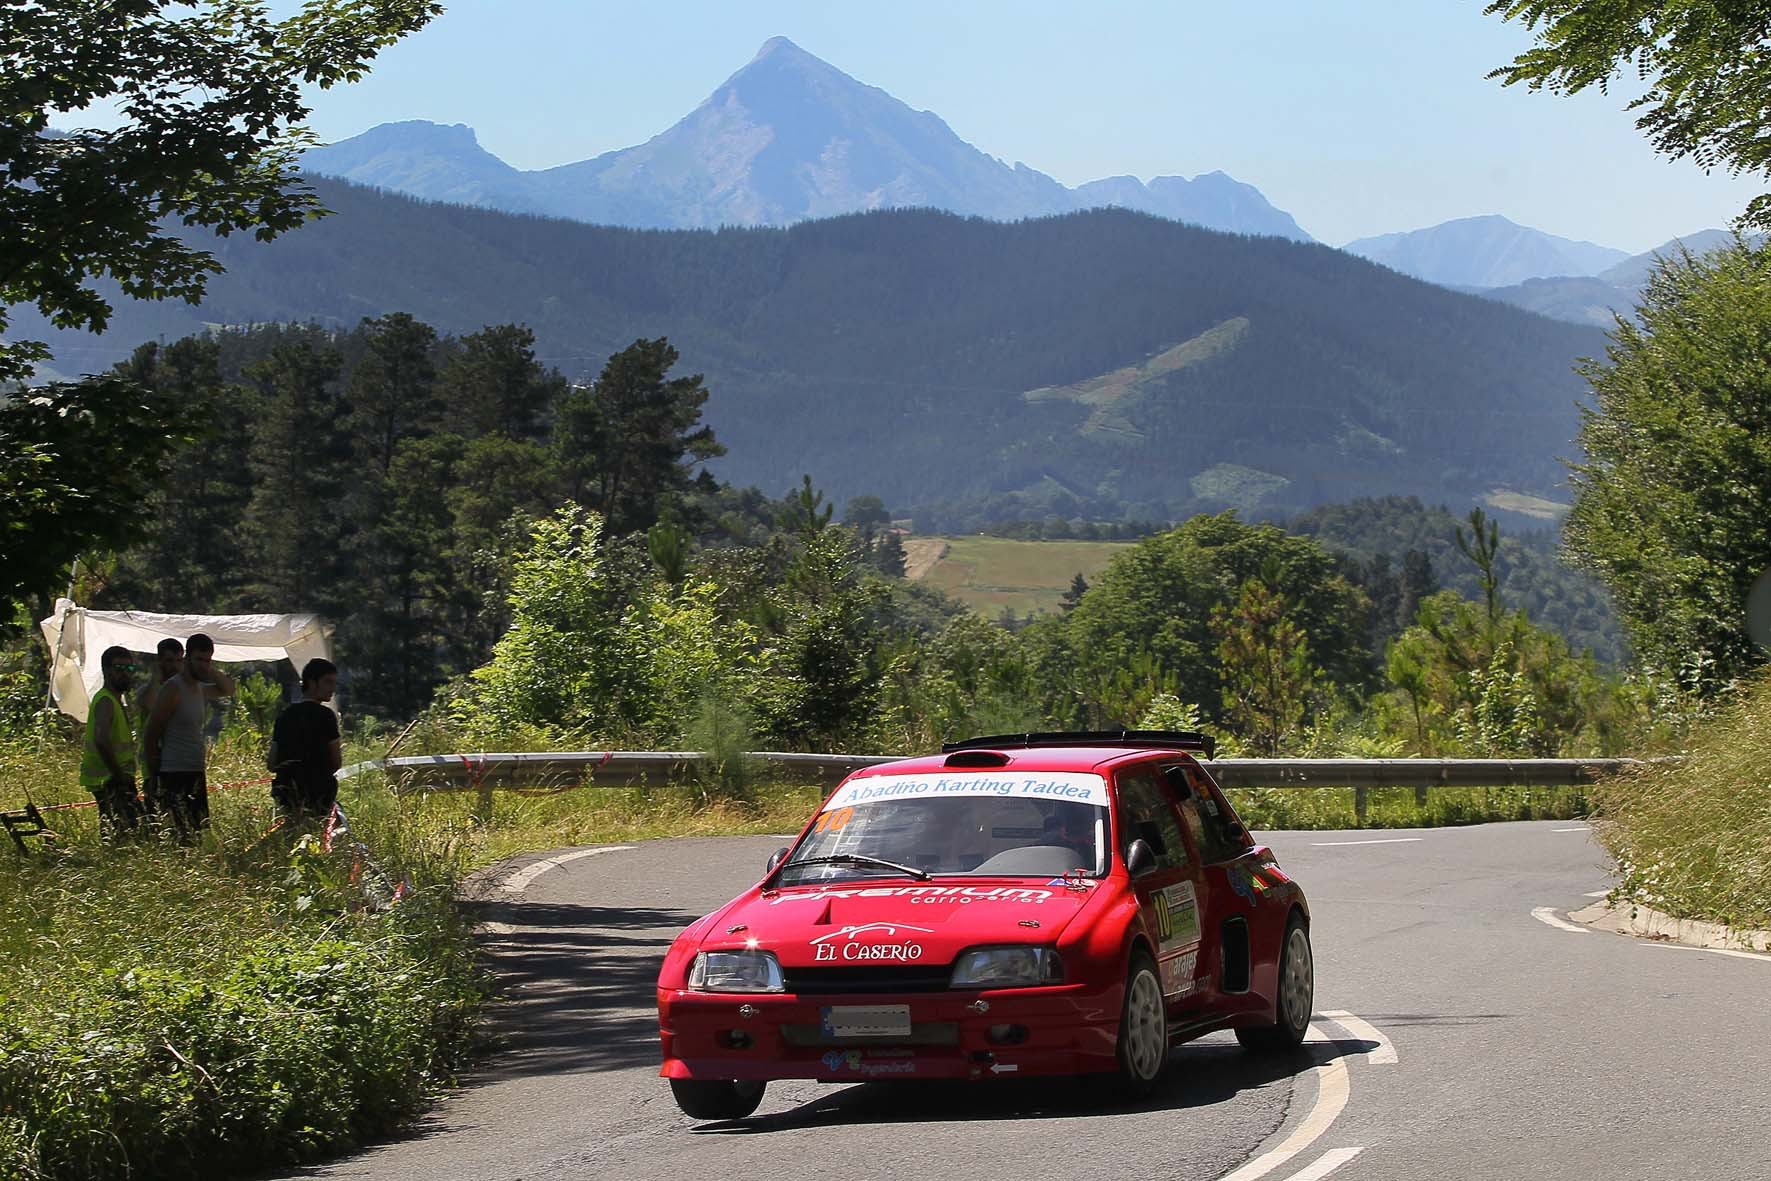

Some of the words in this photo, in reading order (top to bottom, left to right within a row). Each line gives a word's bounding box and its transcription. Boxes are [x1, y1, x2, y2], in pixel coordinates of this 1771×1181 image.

[847, 780, 928, 802] Abadiño
[933, 778, 1014, 795] Karting
[1022, 780, 1092, 799] Taldea
[814, 807, 855, 833] 10
[1153, 894, 1170, 938] 10
